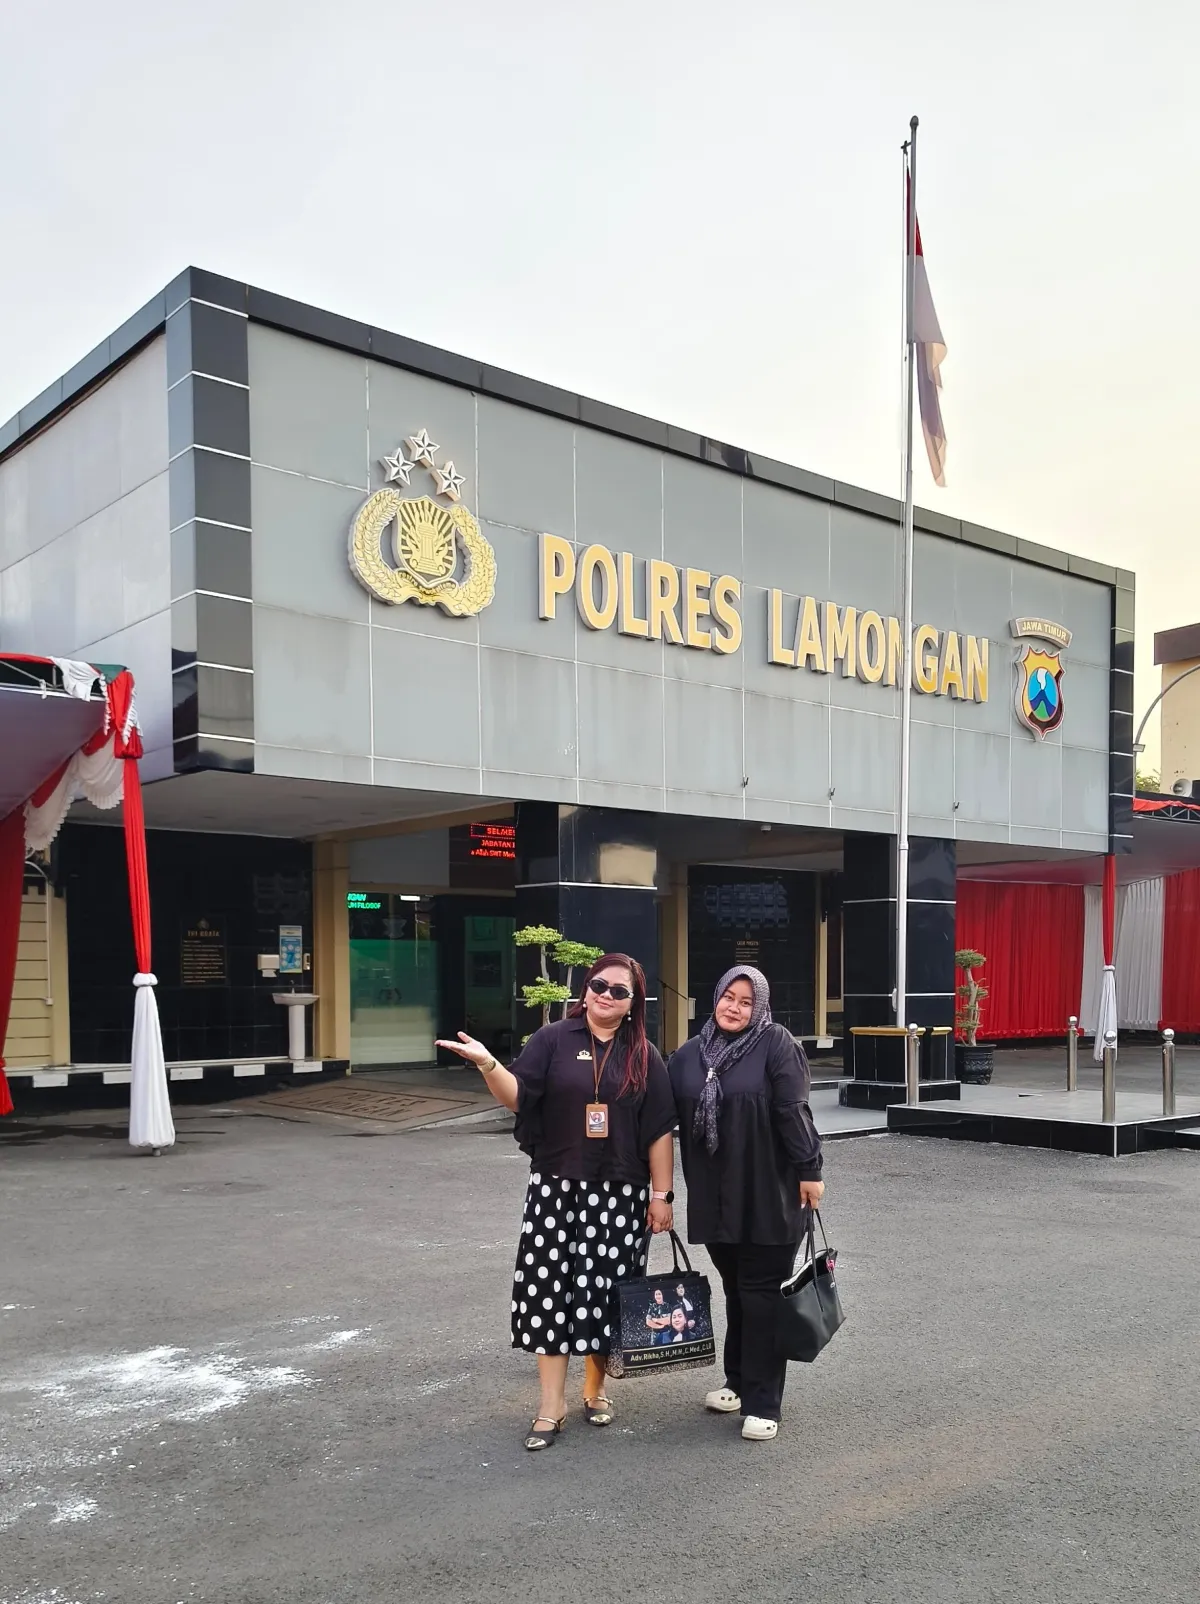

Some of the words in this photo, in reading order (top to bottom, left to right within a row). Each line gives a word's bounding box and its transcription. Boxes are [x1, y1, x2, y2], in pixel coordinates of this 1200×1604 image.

[538, 533, 742, 654] POLRES
[767, 588, 989, 703] LAMONGAN
[1022, 621, 1043, 632] JAWA
[1043, 623, 1067, 641] TIMUR
